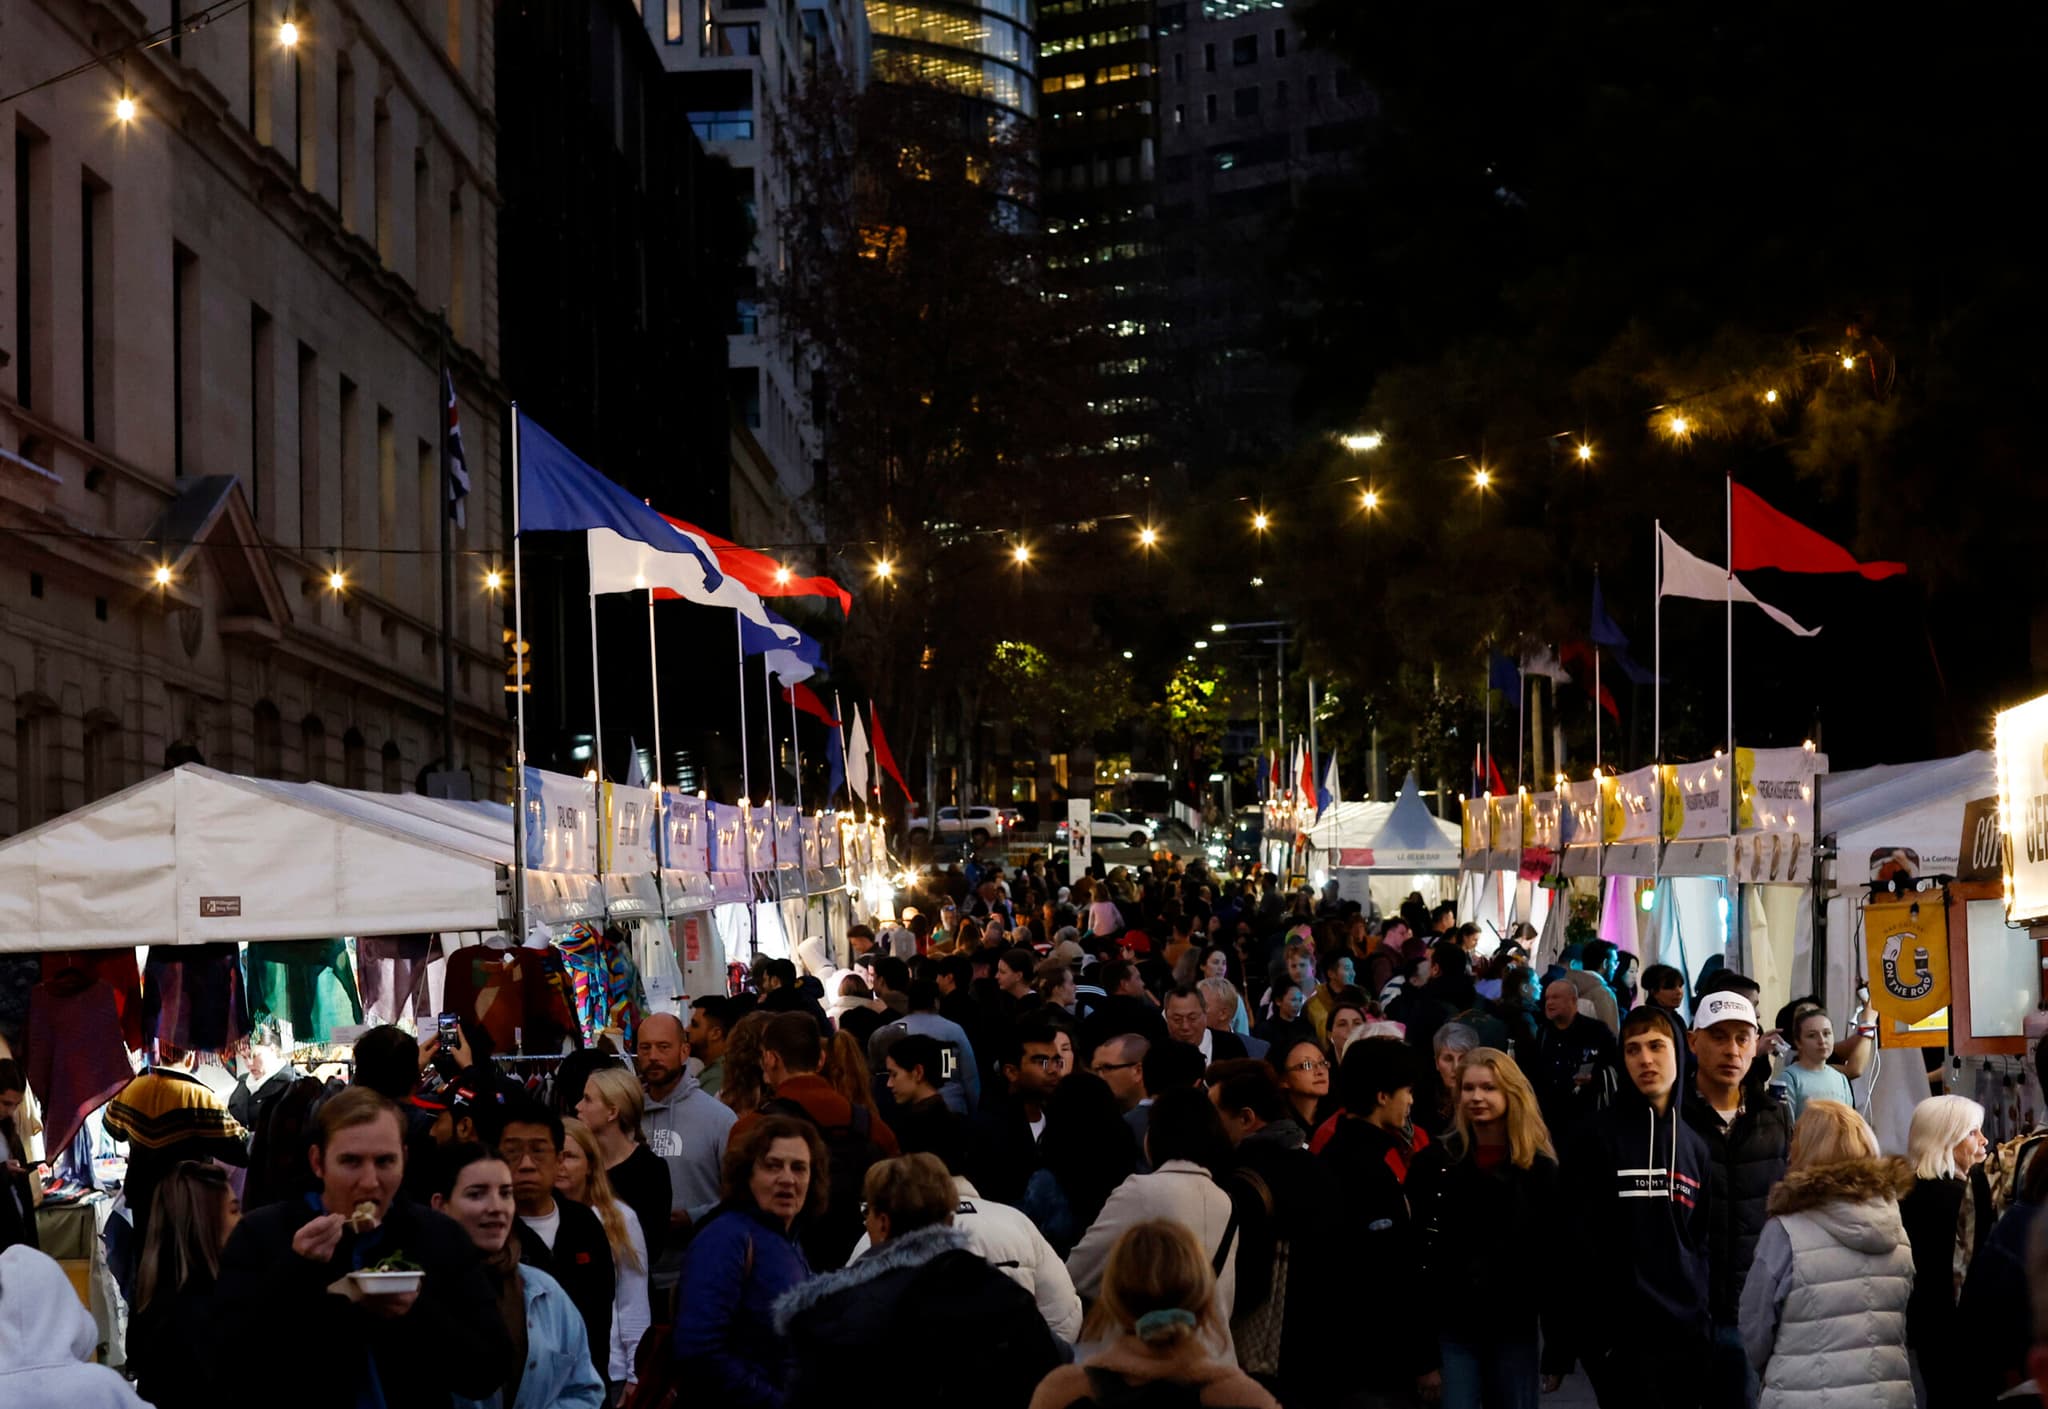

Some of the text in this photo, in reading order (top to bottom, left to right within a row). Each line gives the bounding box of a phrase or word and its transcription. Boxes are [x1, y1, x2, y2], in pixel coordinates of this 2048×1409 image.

[1885, 962, 1931, 996] ON THE ROAD
